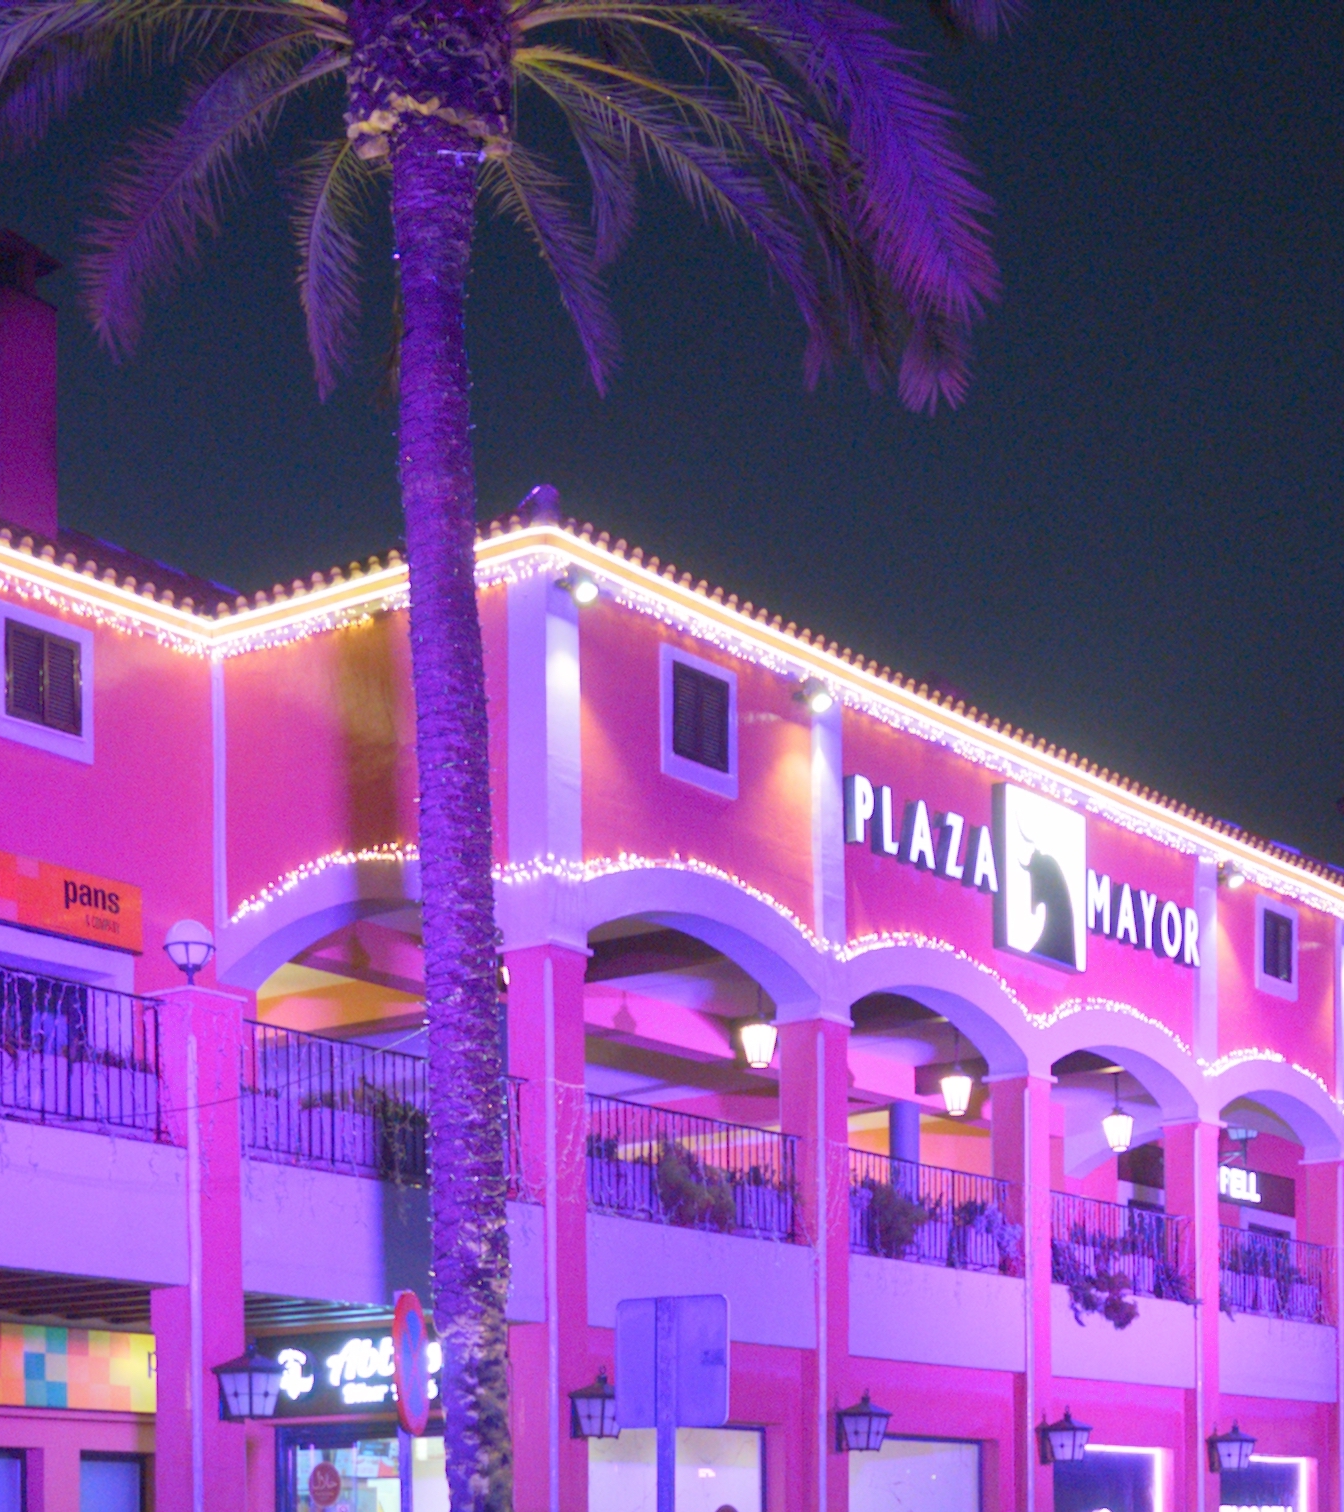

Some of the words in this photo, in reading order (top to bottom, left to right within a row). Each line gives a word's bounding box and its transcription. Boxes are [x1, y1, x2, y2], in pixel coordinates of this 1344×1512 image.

[63, 880, 120, 914] pans
[846, 774, 998, 892] PLAZA
[1087, 868, 1201, 968] MAYOR
